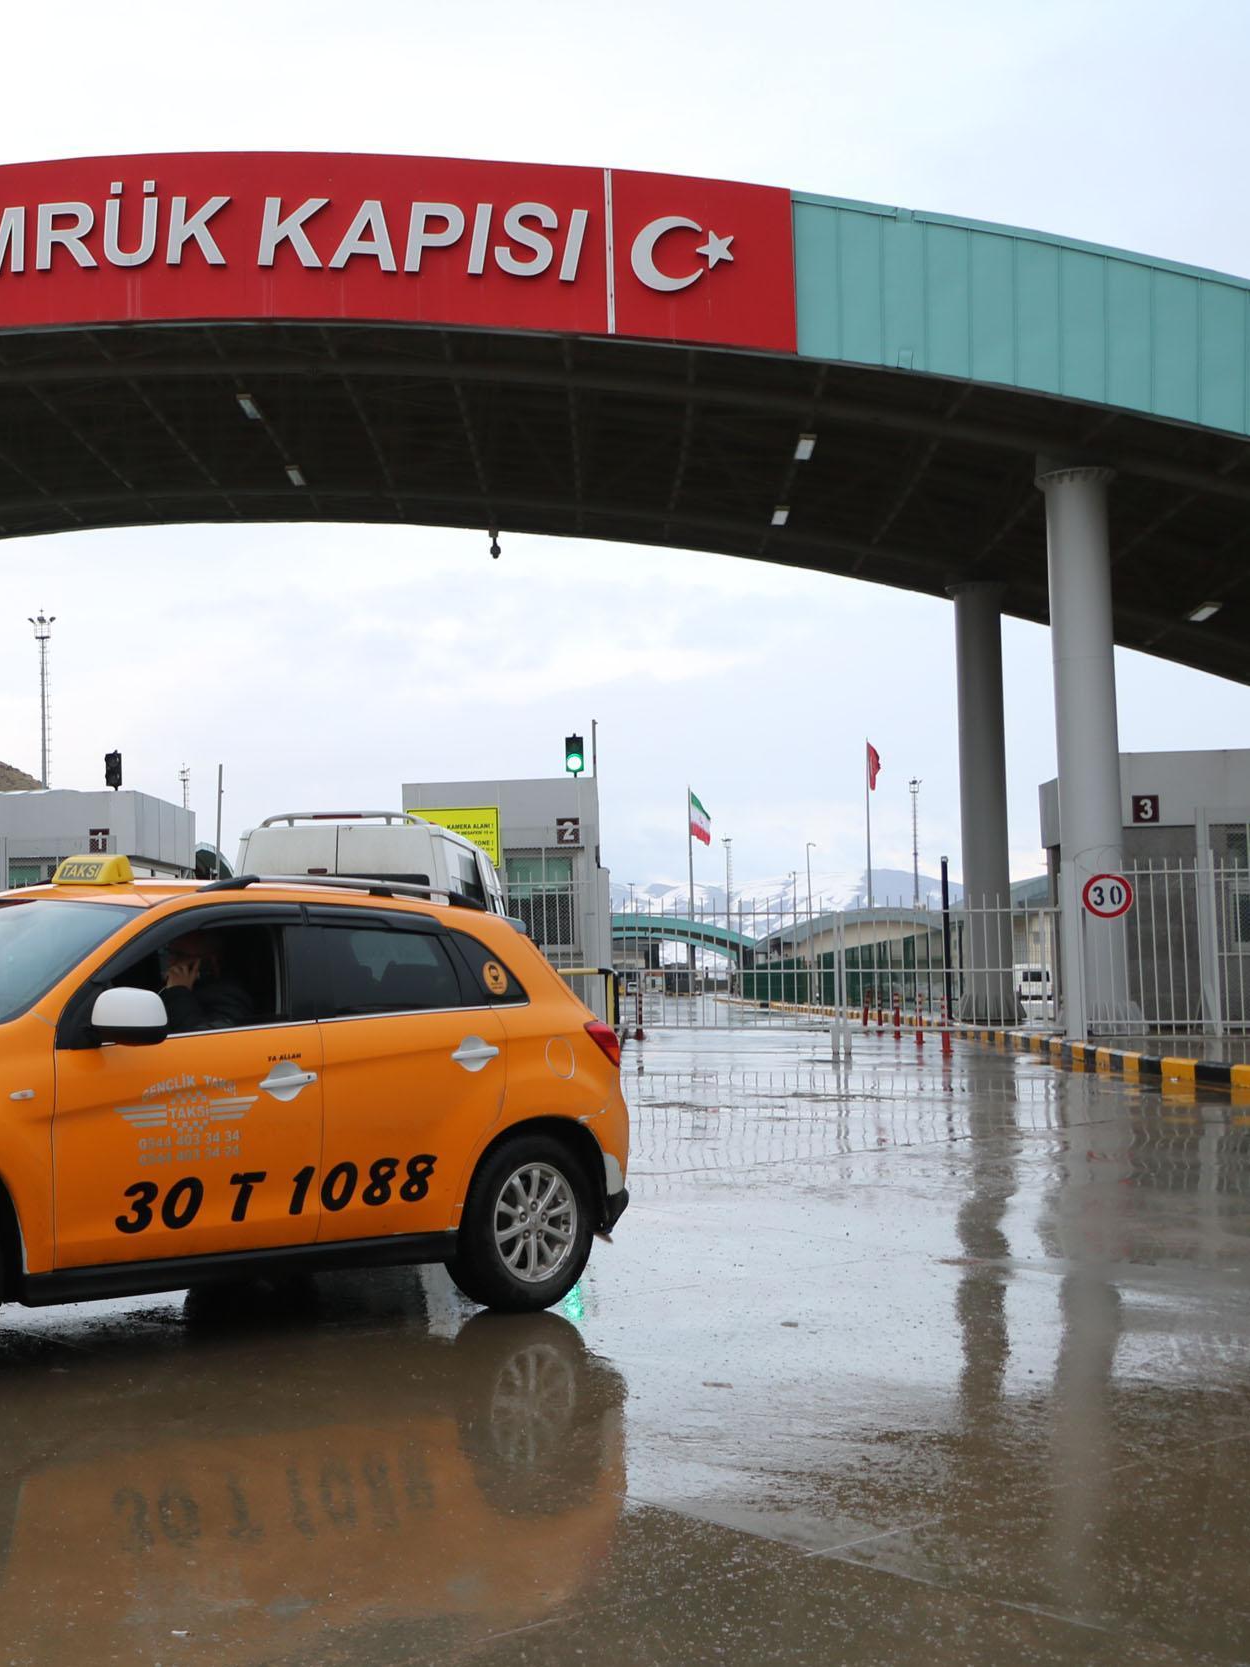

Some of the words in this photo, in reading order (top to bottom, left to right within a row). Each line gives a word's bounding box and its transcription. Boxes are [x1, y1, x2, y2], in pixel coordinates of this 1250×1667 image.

[257, 197, 588, 282] KAPISI
[1139, 799, 1153, 819] 3
[563, 821, 575, 840] 2
[95, 832, 103, 850] 1
[1092, 885, 1123, 906] 30
[176, 1134, 201, 1146] 403
[205, 1132, 221, 1143] 34
[224, 1129, 240, 1141] 34
[115, 1176, 205, 1234] 30
[230, 1170, 267, 1222] T
[288, 1153, 438, 1216] 1088
